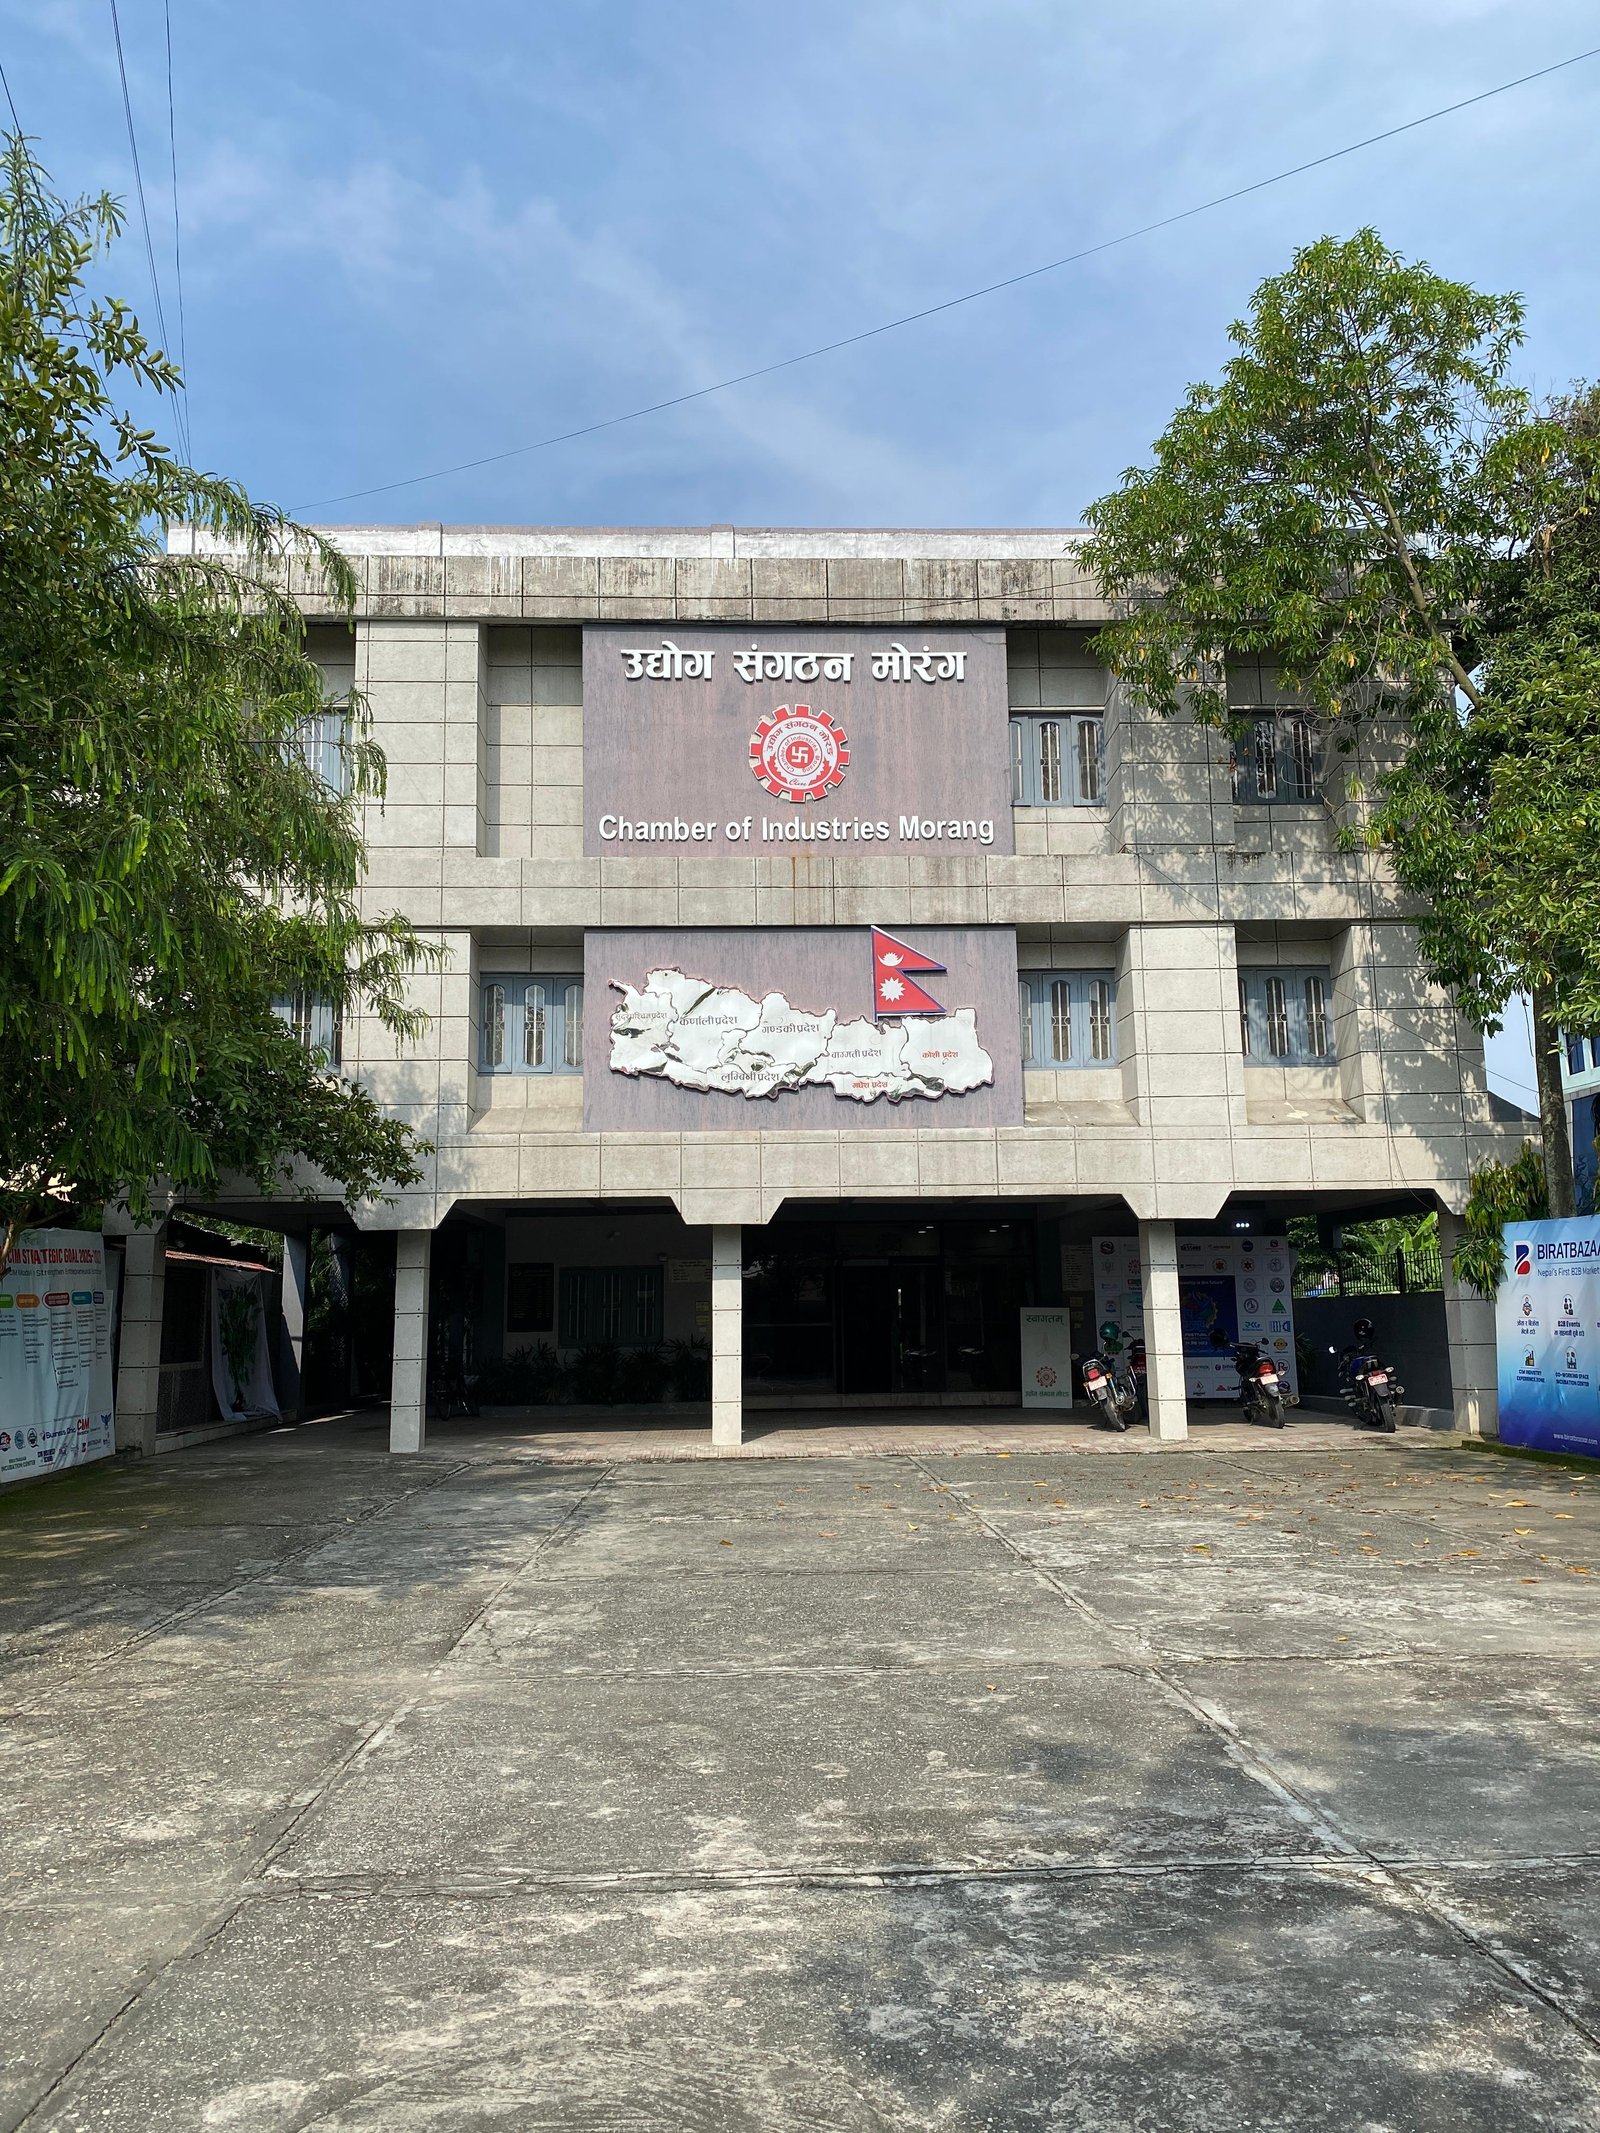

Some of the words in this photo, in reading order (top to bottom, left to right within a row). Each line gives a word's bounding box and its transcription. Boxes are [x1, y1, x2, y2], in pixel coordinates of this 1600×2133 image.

[621, 640, 715, 680] उद्योग
[733, 643, 854, 682] संगठन
[872, 643, 967, 683] मोरंग
[599, 814, 716, 841] Chamber
[725, 815, 752, 841] of
[762, 816, 890, 841] Industries
[899, 816, 994, 845] Morang
[1537, 1240, 1600, 1259] BIRATBAZA
[1537, 1268, 1558, 1279] Nepal's
[1571, 1267, 1582, 1276] B2B
[1026, 1314, 1064, 1325] स्वागतम्
